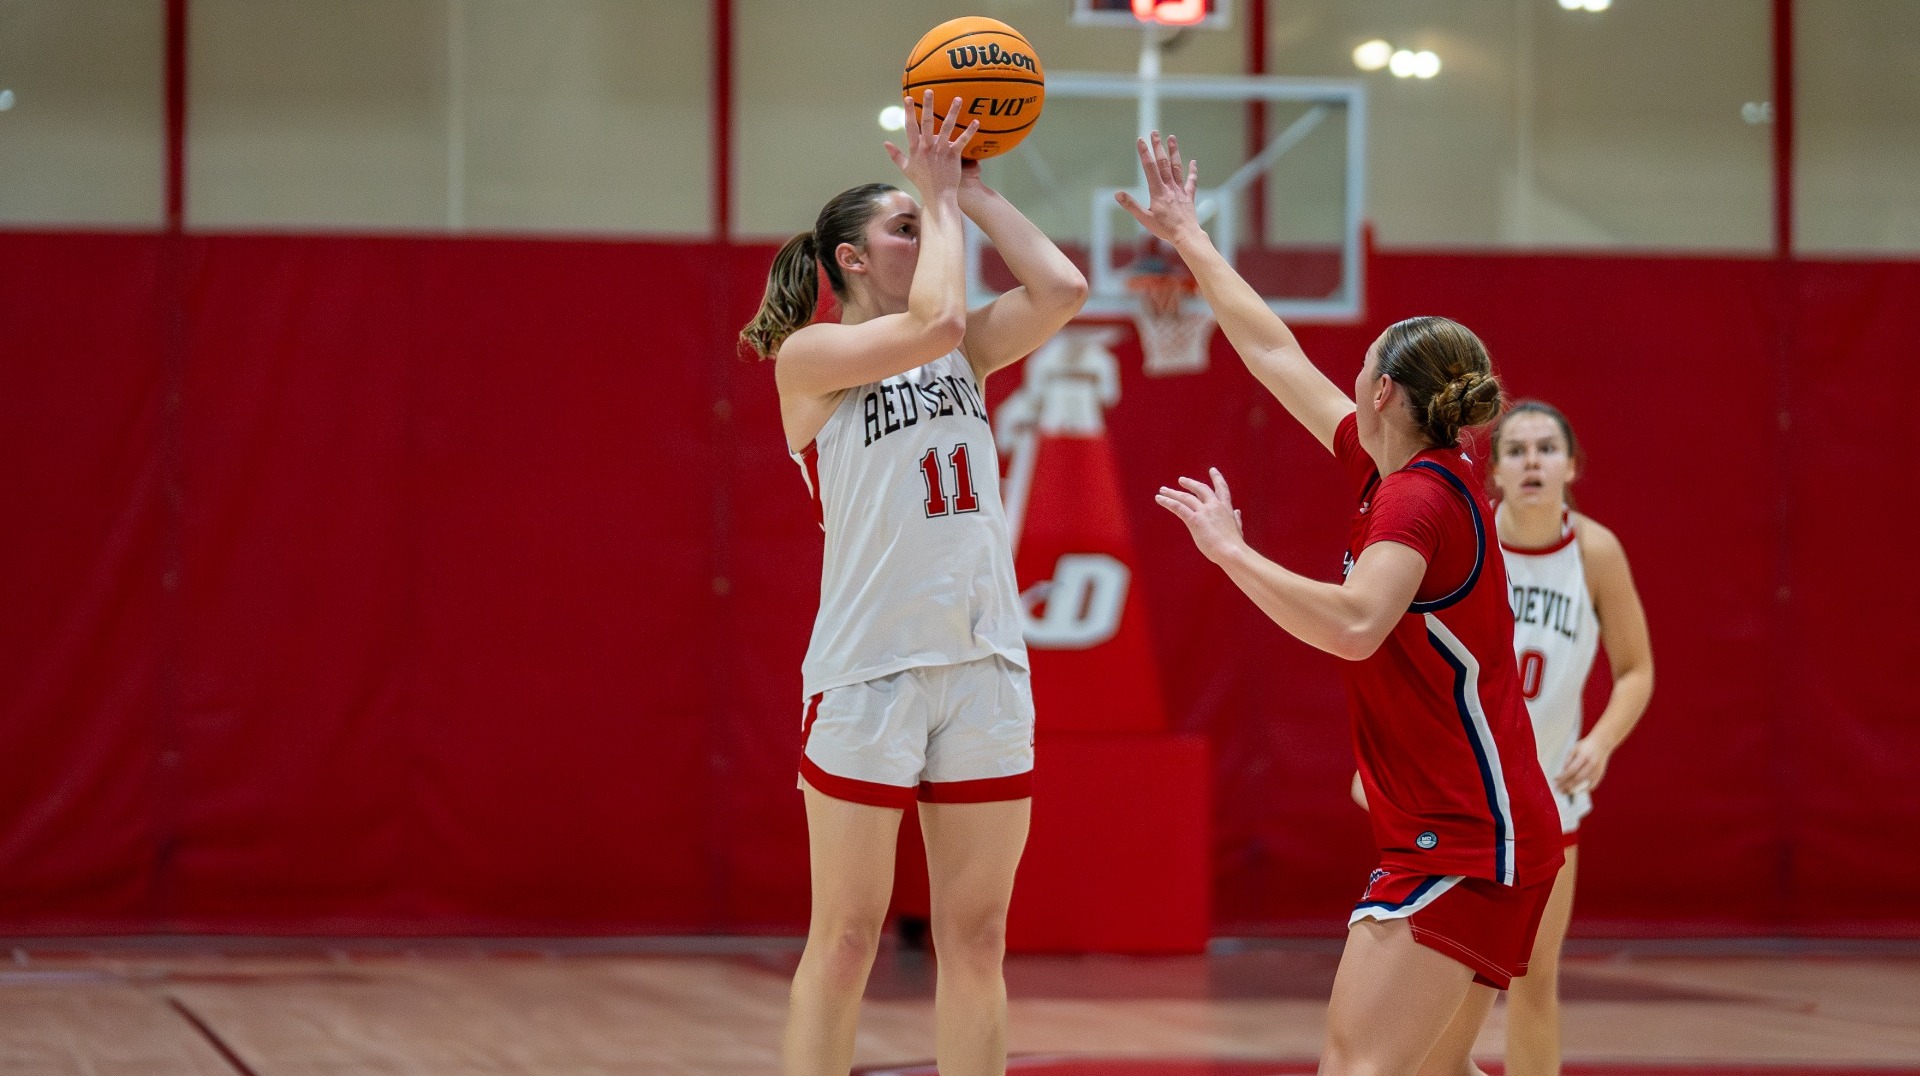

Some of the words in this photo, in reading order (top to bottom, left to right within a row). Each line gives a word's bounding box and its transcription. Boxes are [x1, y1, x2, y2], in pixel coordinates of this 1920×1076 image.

[946, 42, 1039, 75] Wilson
[968, 97, 1025, 117] EVO
[864, 380, 919, 448] RED
[915, 374, 989, 425] DEVIL
[919, 442, 980, 519] 11
[1512, 585, 1577, 643] DEVIL
[1519, 649, 1545, 702] 0
